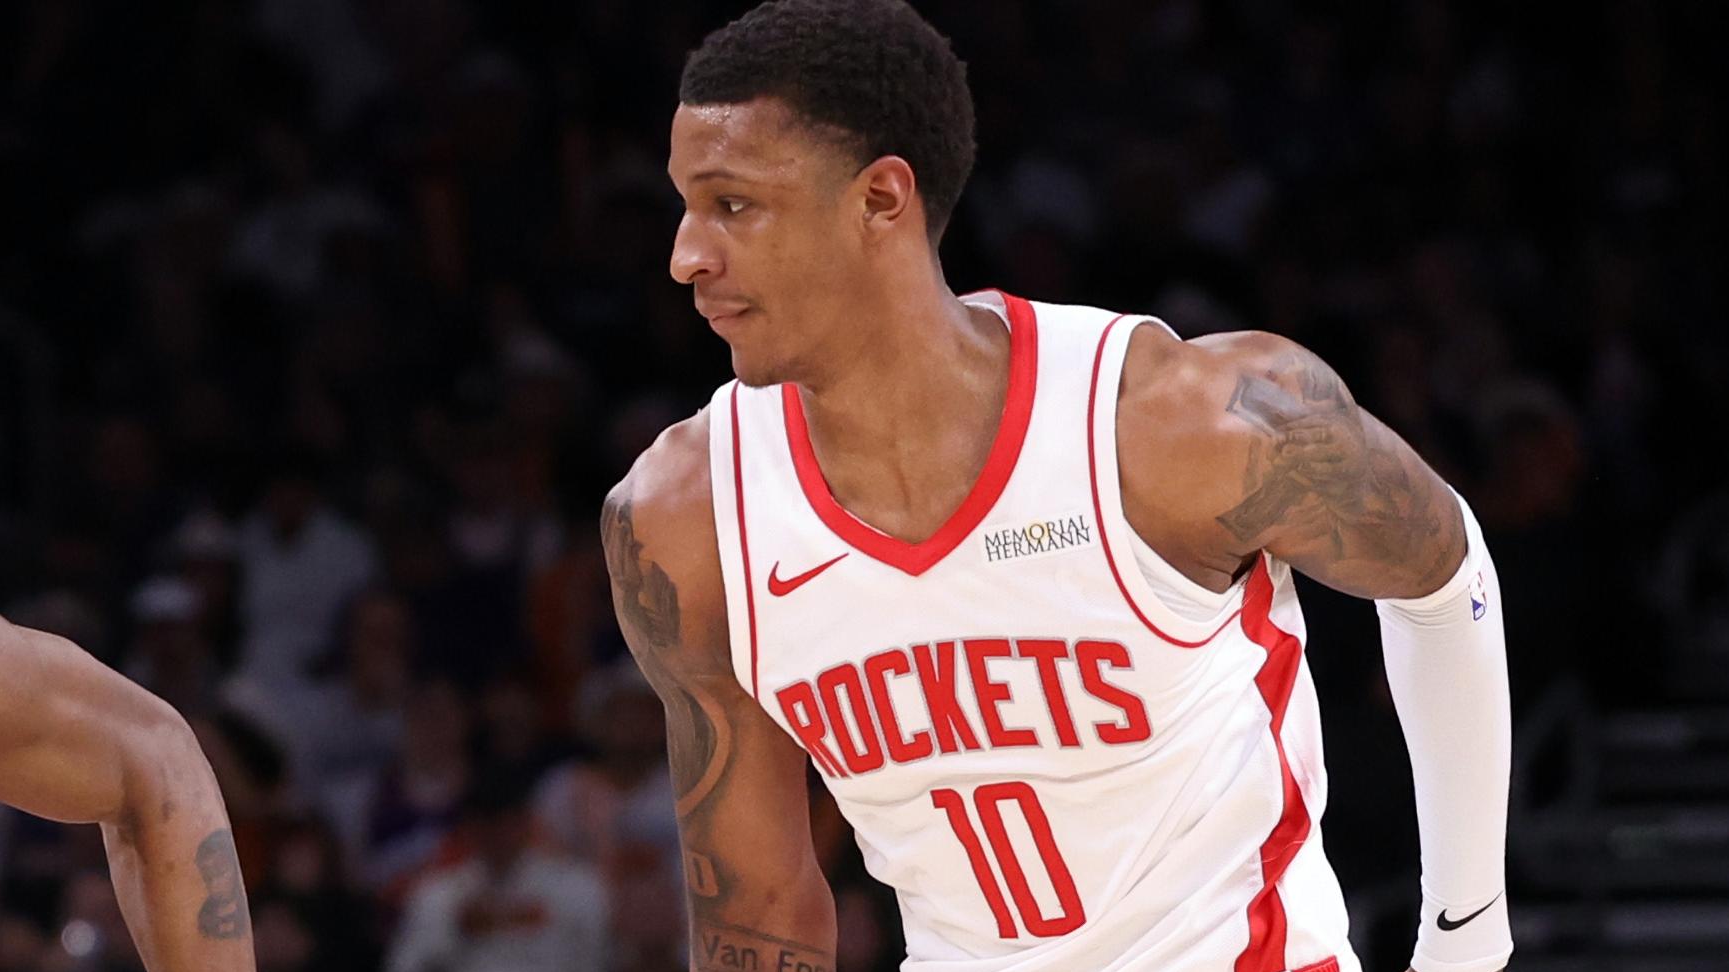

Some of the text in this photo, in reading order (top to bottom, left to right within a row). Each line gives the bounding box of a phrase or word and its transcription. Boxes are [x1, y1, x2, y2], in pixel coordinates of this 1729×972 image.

[984, 514, 1090, 548] MEMORIAL
[985, 527, 1091, 562] HERMANN
[774, 636, 1153, 779] ROCKETS
[930, 781, 1087, 940] 10
[702, 932, 759, 971] Van
